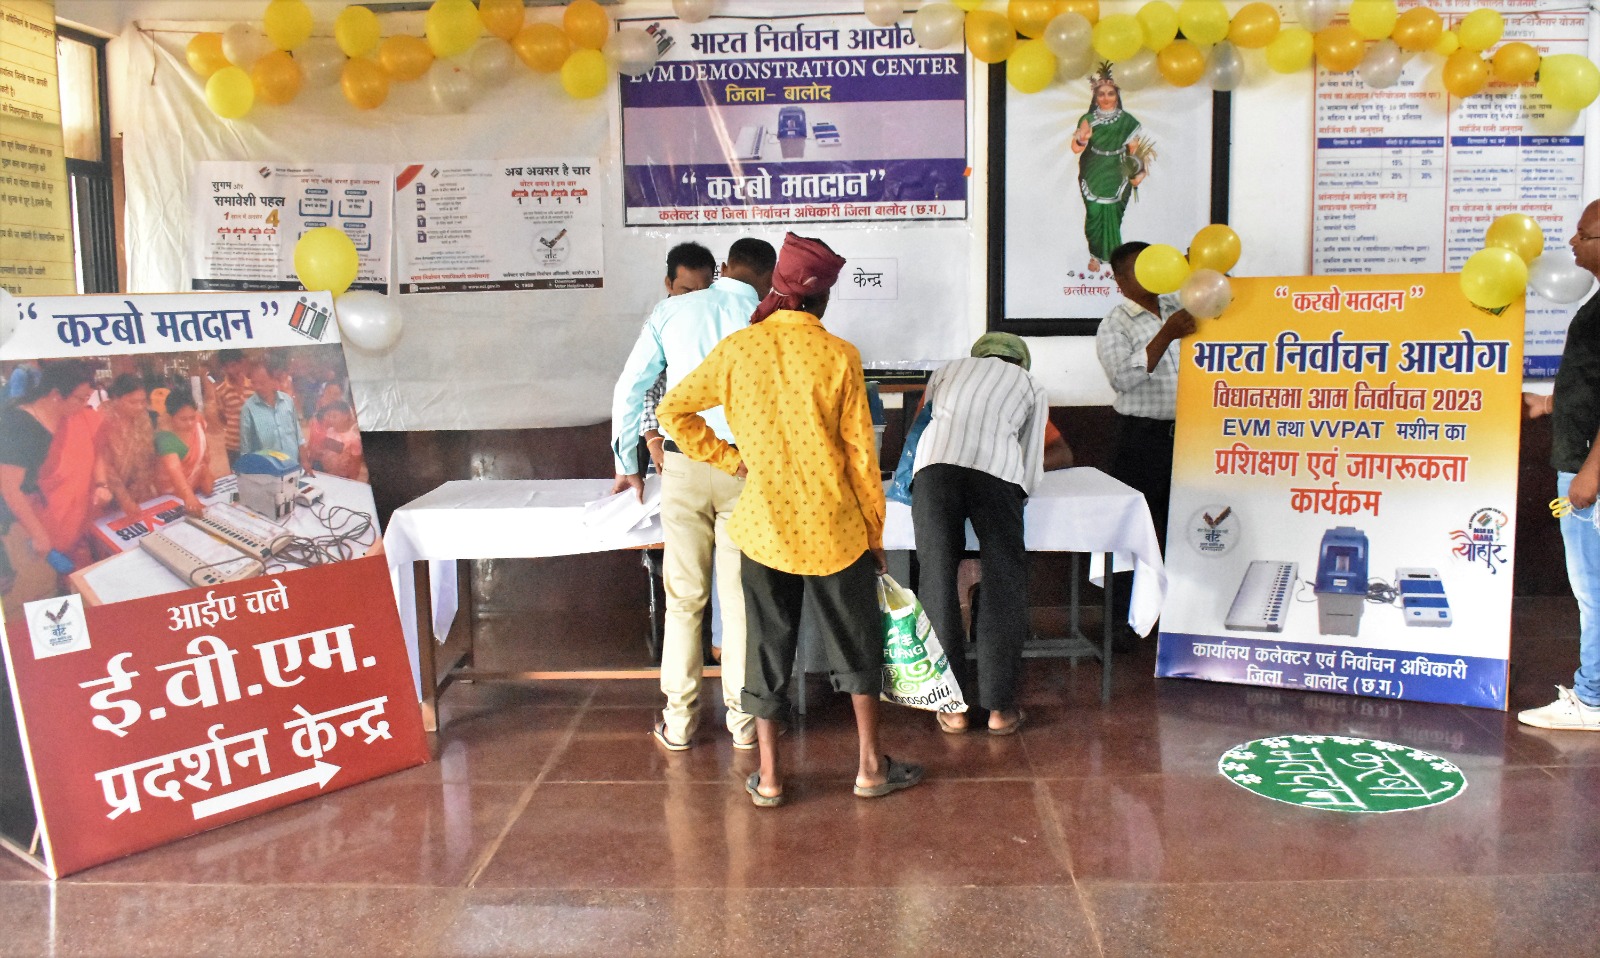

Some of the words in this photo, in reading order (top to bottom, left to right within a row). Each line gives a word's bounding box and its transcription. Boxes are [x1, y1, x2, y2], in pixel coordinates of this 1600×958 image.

[691, 33, 748, 54] भारत
[754, 23, 839, 53] निर्वाचन
[679, 59, 867, 81] DEMONSTRATION
[872, 57, 959, 77] CENTER
[783, 82, 833, 101] बालोद
[505, 167, 523, 176] अब
[527, 167, 559, 176] अवसर
[562, 163, 569, 176] है
[572, 167, 591, 175] चार
[706, 168, 772, 200] करबो
[212, 181, 232, 192] सुगम
[213, 193, 256, 206] समावेशी
[260, 196, 286, 207] पहल
[266, 209, 279, 227] 4
[659, 207, 699, 221] कलेक्टर
[703, 207, 719, 220] एवं
[722, 206, 748, 219] जिला
[751, 204, 790, 219] निर्वाचन
[794, 203, 840, 217] अधिकारी
[844, 203, 871, 217] जिला
[874, 202, 907, 216] बालोद
[853, 267, 883, 287] केन्द्र
[1292, 286, 1341, 311] करबो
[1344, 290, 1405, 311] मतदान
[52, 300, 147, 347] करबो
[151, 309, 253, 342] मतदान
[1194, 341, 1267, 373] भारत
[1275, 331, 1389, 373] निर्वाचन
[1399, 331, 1510, 374] आयोग
[1213, 380, 1302, 409] विधानसभा
[1308, 387, 1349, 409] आम
[1353, 380, 1427, 411] निर्वाचन
[1433, 389, 1482, 412] 2023
[1223, 419, 1270, 436] EVM
[1277, 421, 1305, 438] तथा
[1311, 421, 1384, 439] VVPAT
[1396, 418, 1439, 440] मशीन
[1445, 423, 1467, 441] का
[1214, 443, 1299, 476] प्रशिक्षण
[1307, 447, 1339, 481] एवं
[1346, 453, 1469, 483] जागरूकता
[1290, 482, 1382, 517] कार्यक्रम
[167, 591, 237, 632] आईए
[243, 579, 289, 616] चले
[1192, 641, 1250, 660] कार्यालय
[1255, 646, 1311, 665] कलेक्टर
[1315, 651, 1337, 669] एवं
[1341, 650, 1396, 673] निर्वाचन
[1400, 656, 1468, 680] अधिकारी
[79, 624, 377, 738] ई.वी.एम.
[1246, 663, 1283, 684] जिला
[1304, 671, 1349, 691] बालोद
[95, 723, 272, 820] प्रदर्शन
[284, 696, 393, 760] केन्द्र
